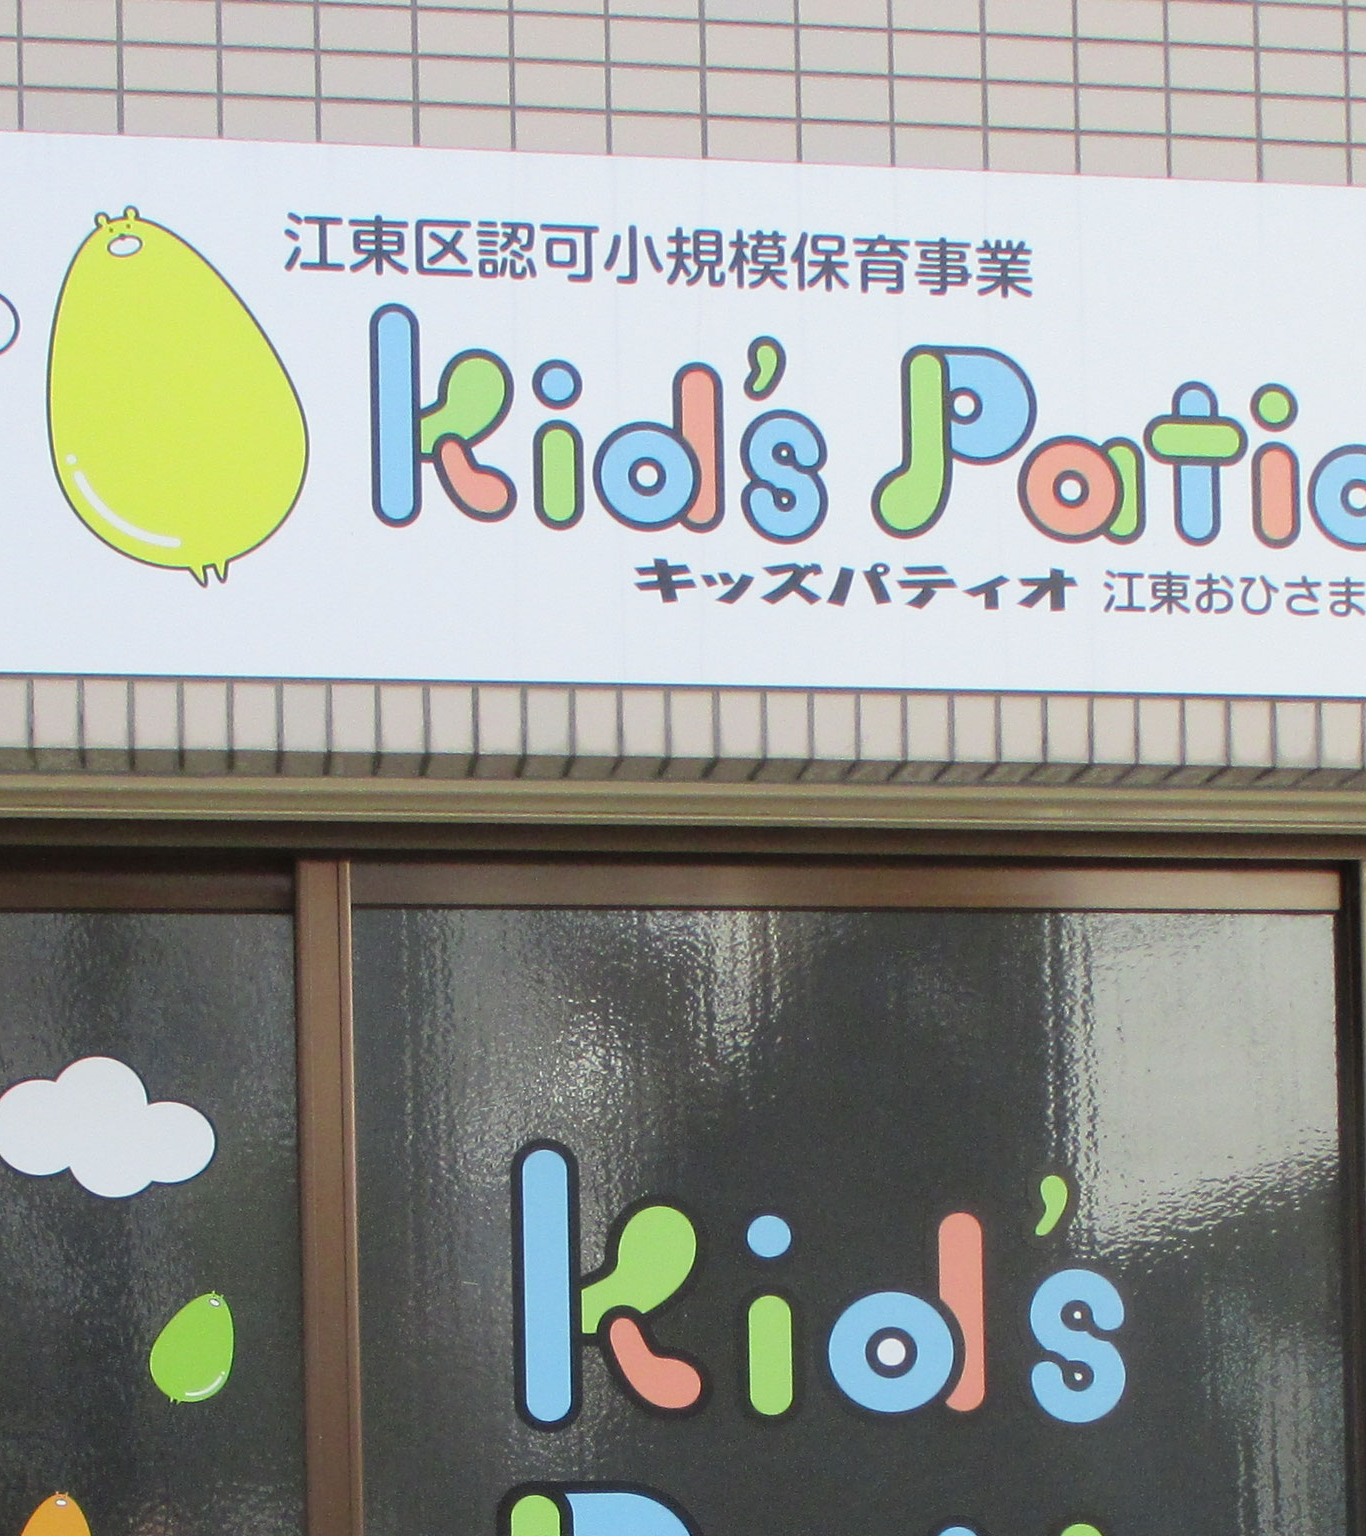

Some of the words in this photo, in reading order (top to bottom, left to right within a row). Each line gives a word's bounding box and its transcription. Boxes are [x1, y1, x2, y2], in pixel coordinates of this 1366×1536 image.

[283, 212, 1034, 299] 江東区認可小規模保育事業
[634, 557, 1079, 613] キッズパティオ
